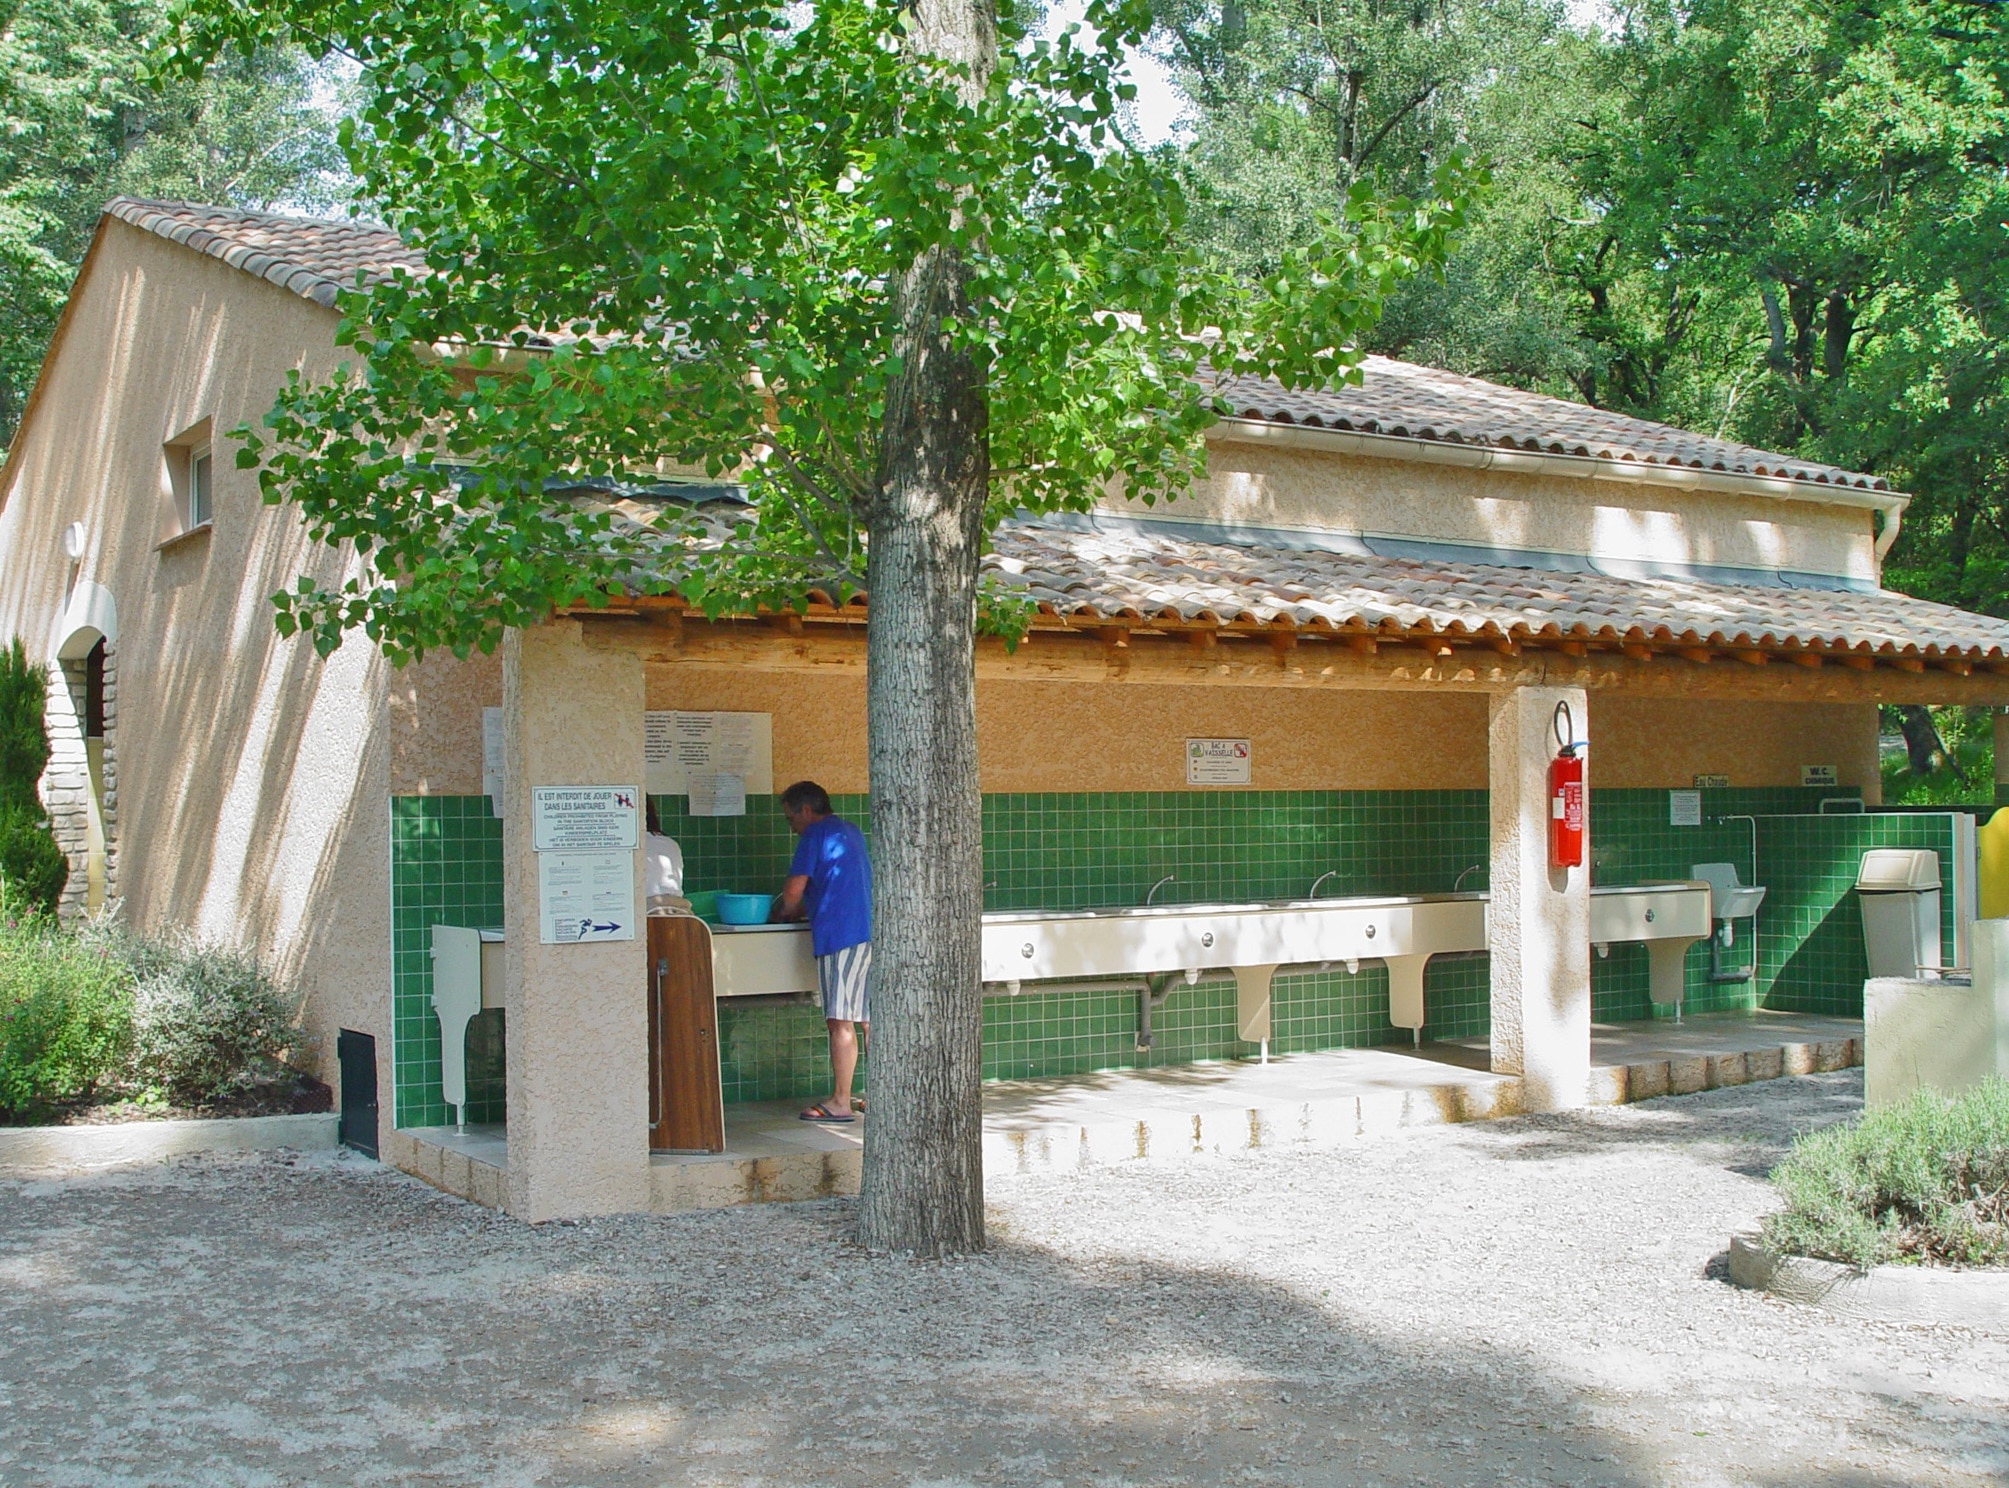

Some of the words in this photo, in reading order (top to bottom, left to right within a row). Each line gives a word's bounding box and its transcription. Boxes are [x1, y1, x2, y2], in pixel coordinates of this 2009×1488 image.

[1809, 767, 1830, 776] W.C.
[537, 793, 543, 801] IL
[544, 793, 555, 801] EST
[556, 792, 582, 801] INTERDIT
[583, 792, 591, 800] DE
[593, 792, 612, 800] JOUER
[544, 803, 560, 811] DANS
[561, 803, 571, 811] LES
[573, 802, 606, 810] SANITAIRES
